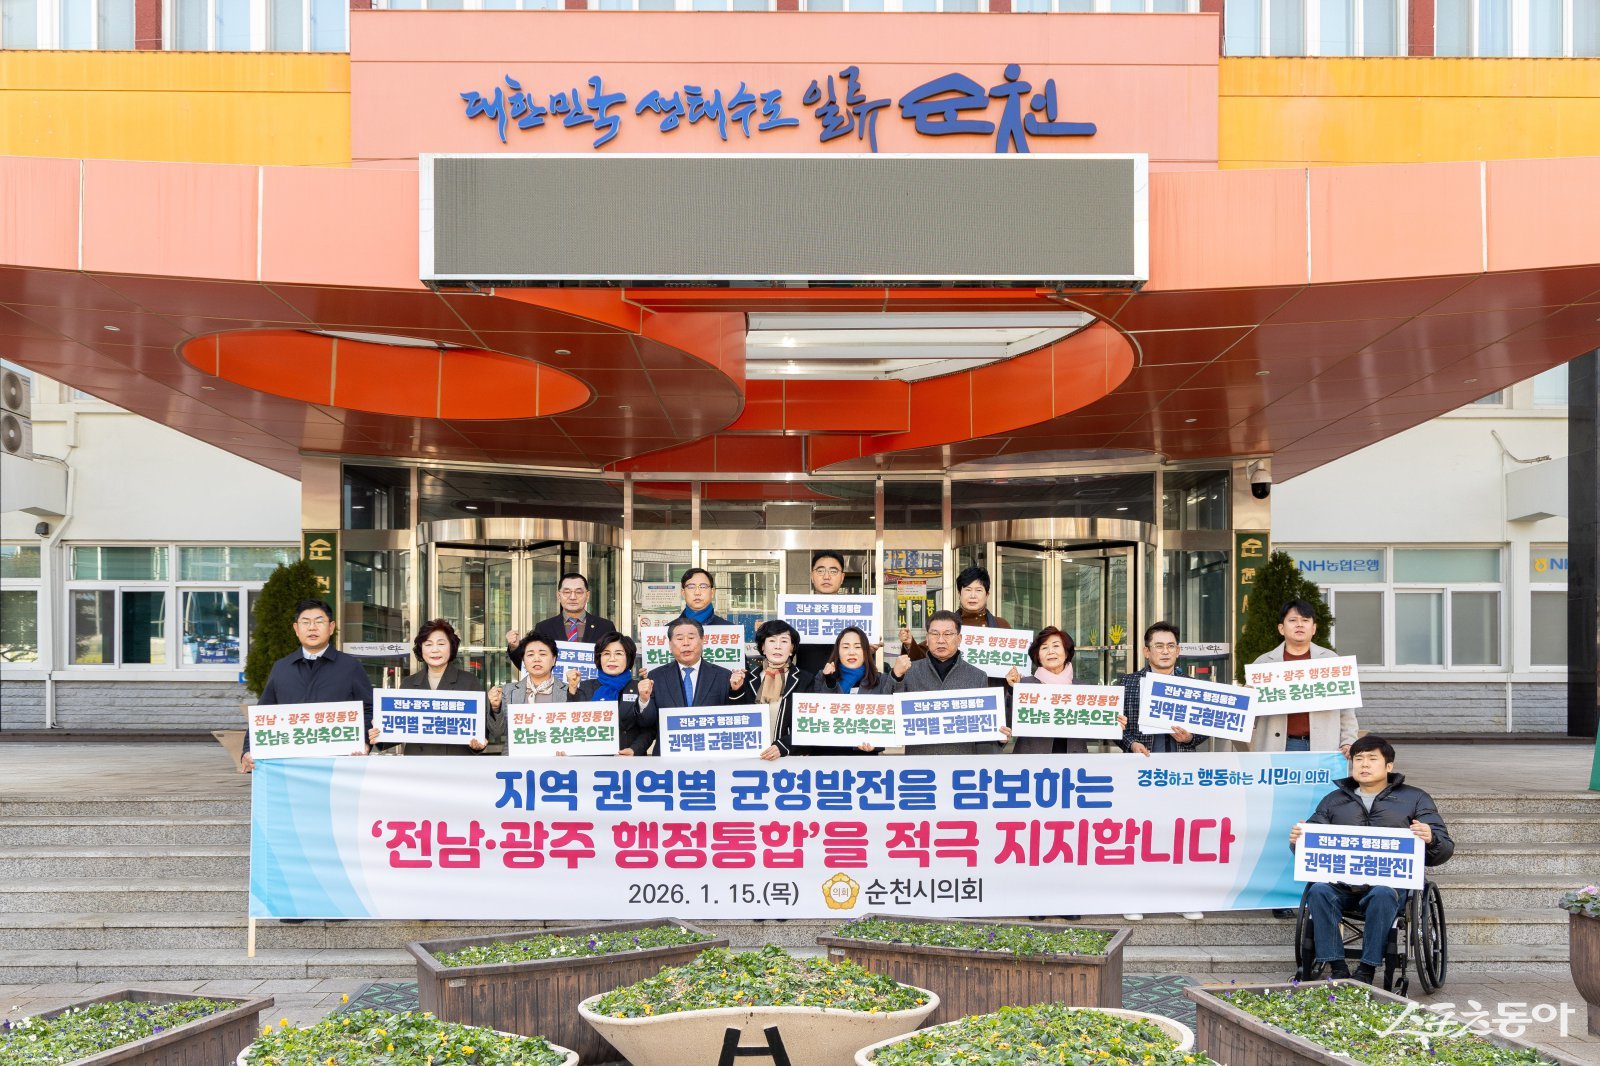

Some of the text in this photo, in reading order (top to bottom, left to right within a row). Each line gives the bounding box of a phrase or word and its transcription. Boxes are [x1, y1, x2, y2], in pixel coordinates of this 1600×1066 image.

[460, 63, 1097, 153] 대한민국 생태수도 일류 순천
[1298, 559, 1379, 572] NH농협은행
[796, 602, 862, 614] 전남·광주 행정통합
[646, 635, 666, 645] 전남
[965, 634, 1028, 649] 광주 행정통합
[647, 649, 675, 665] 호남
[703, 648, 740, 662] 축으로!
[967, 648, 1028, 667] 중심축으로!
[1252, 672, 1272, 684] 전남
[1283, 669, 1305, 682] 광주
[1309, 665, 1353, 679] 행정통합
[1018, 692, 1041, 705] 전남
[1050, 693, 1072, 706] 광주
[1075, 694, 1120, 707] 행정통합
[1164, 685, 1238, 706] 전남·광주 행정통합
[1289, 680, 1355, 700] 중심축으로!
[393, 699, 466, 711] 전남·광주 행정통합
[798, 702, 819, 714] 전남
[829, 703, 851, 715] 광주
[913, 698, 985, 712] 전남·광주 행정통합
[254, 714, 276, 727] 전남
[288, 713, 310, 725] 광주
[315, 710, 359, 724] 행정통합
[382, 715, 477, 736] 권역별 균형발전!
[513, 712, 535, 725] 전남
[545, 711, 567, 724] 광주
[571, 710, 613, 722] 행정통합
[679, 713, 751, 728] 전남·광주 행정통합
[797, 716, 830, 733] 호남을
[903, 713, 998, 736] 권역별 균형발전!
[1017, 706, 1119, 727] 호남을 중심축으로!
[1149, 700, 1246, 733] 권역별 균형발전!
[255, 727, 360, 746] 호남을 중심축으로!
[513, 725, 614, 745] 호남을 중심축으로!
[668, 730, 762, 752] 권역별 균형발전!
[1138, 768, 1330, 787] 경청하고 행동하는 시민의 의회
[496, 768, 1113, 810] 지역 권역별 균형발전을 담보하는
[372, 817, 1235, 868] ‘전남·광주 행정통합’을 적극 지지합니다
[1318, 835, 1401, 850] 전남·광주 행정통합
[1304, 852, 1413, 879] 권역별 균형발전!
[629, 882, 798, 905] 2026. 1. 15.(목)
[832, 888, 849, 898] 의회
[865, 878, 982, 904] 순천시의회
